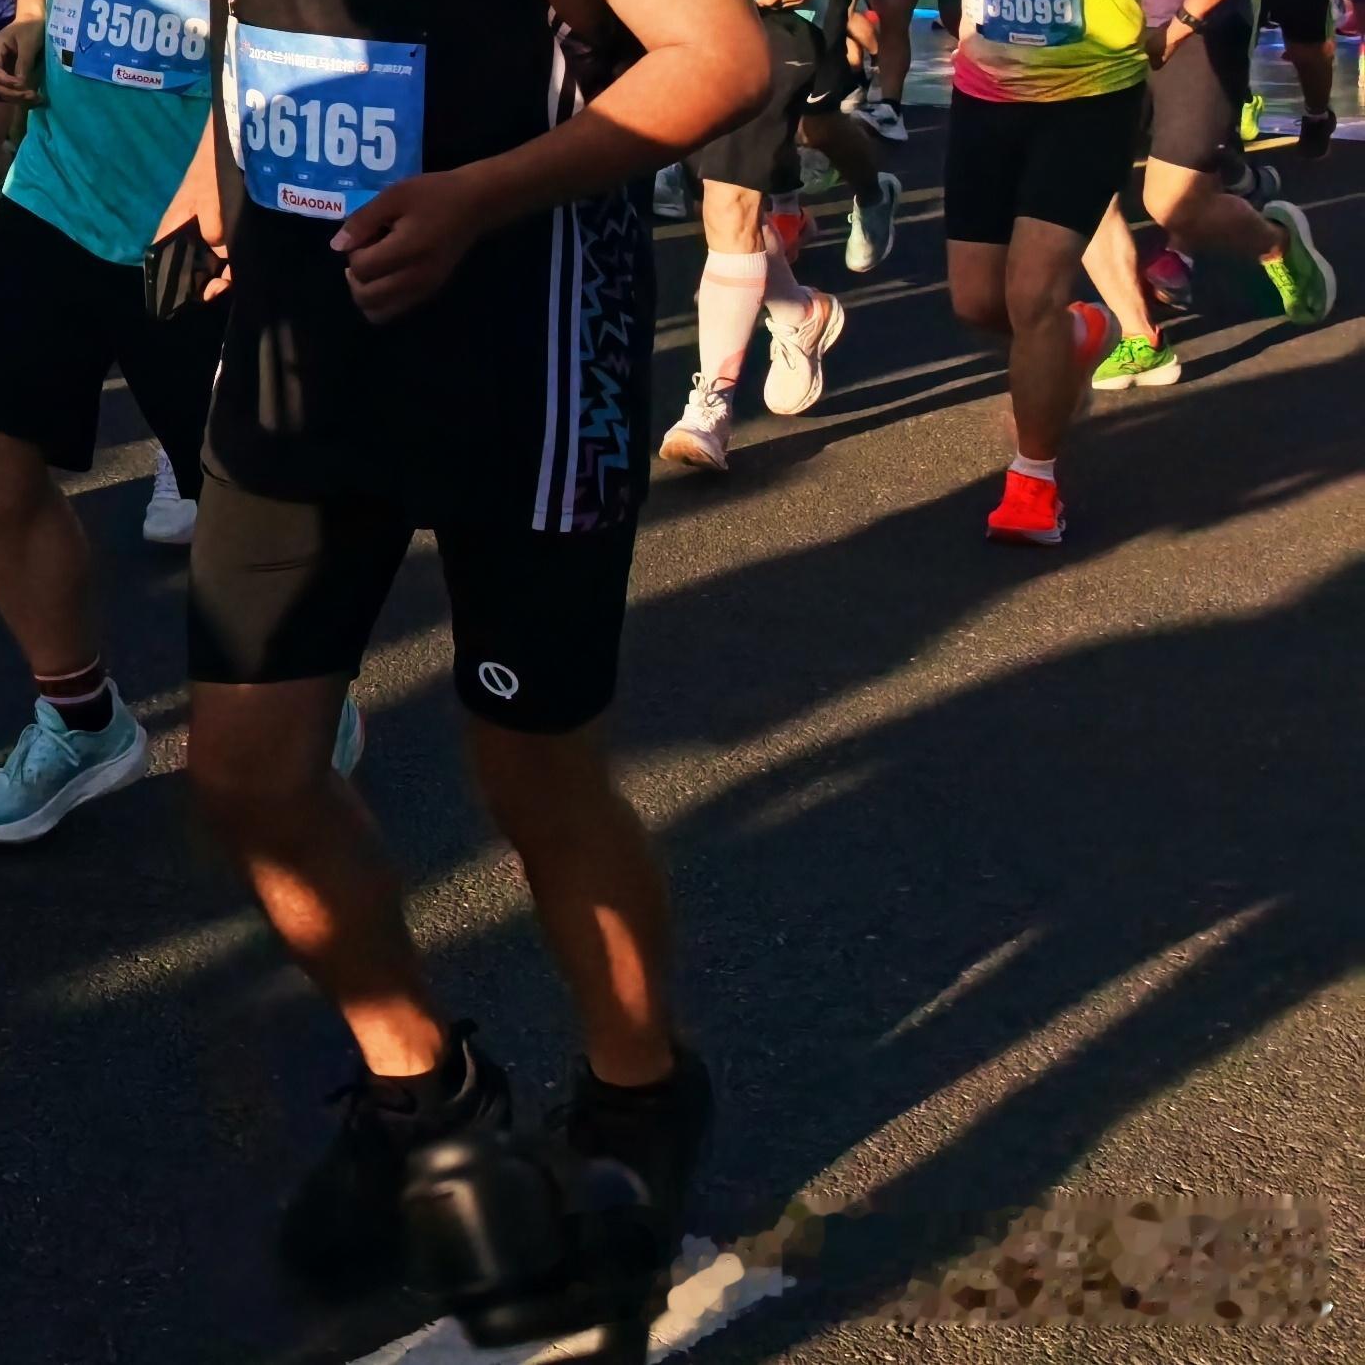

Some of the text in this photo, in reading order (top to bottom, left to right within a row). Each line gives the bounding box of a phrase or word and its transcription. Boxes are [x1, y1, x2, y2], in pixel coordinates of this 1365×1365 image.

[87, 0, 208, 61] 35088
[245, 88, 397, 172] 36165
[289, 195, 342, 212] QIAODAN
